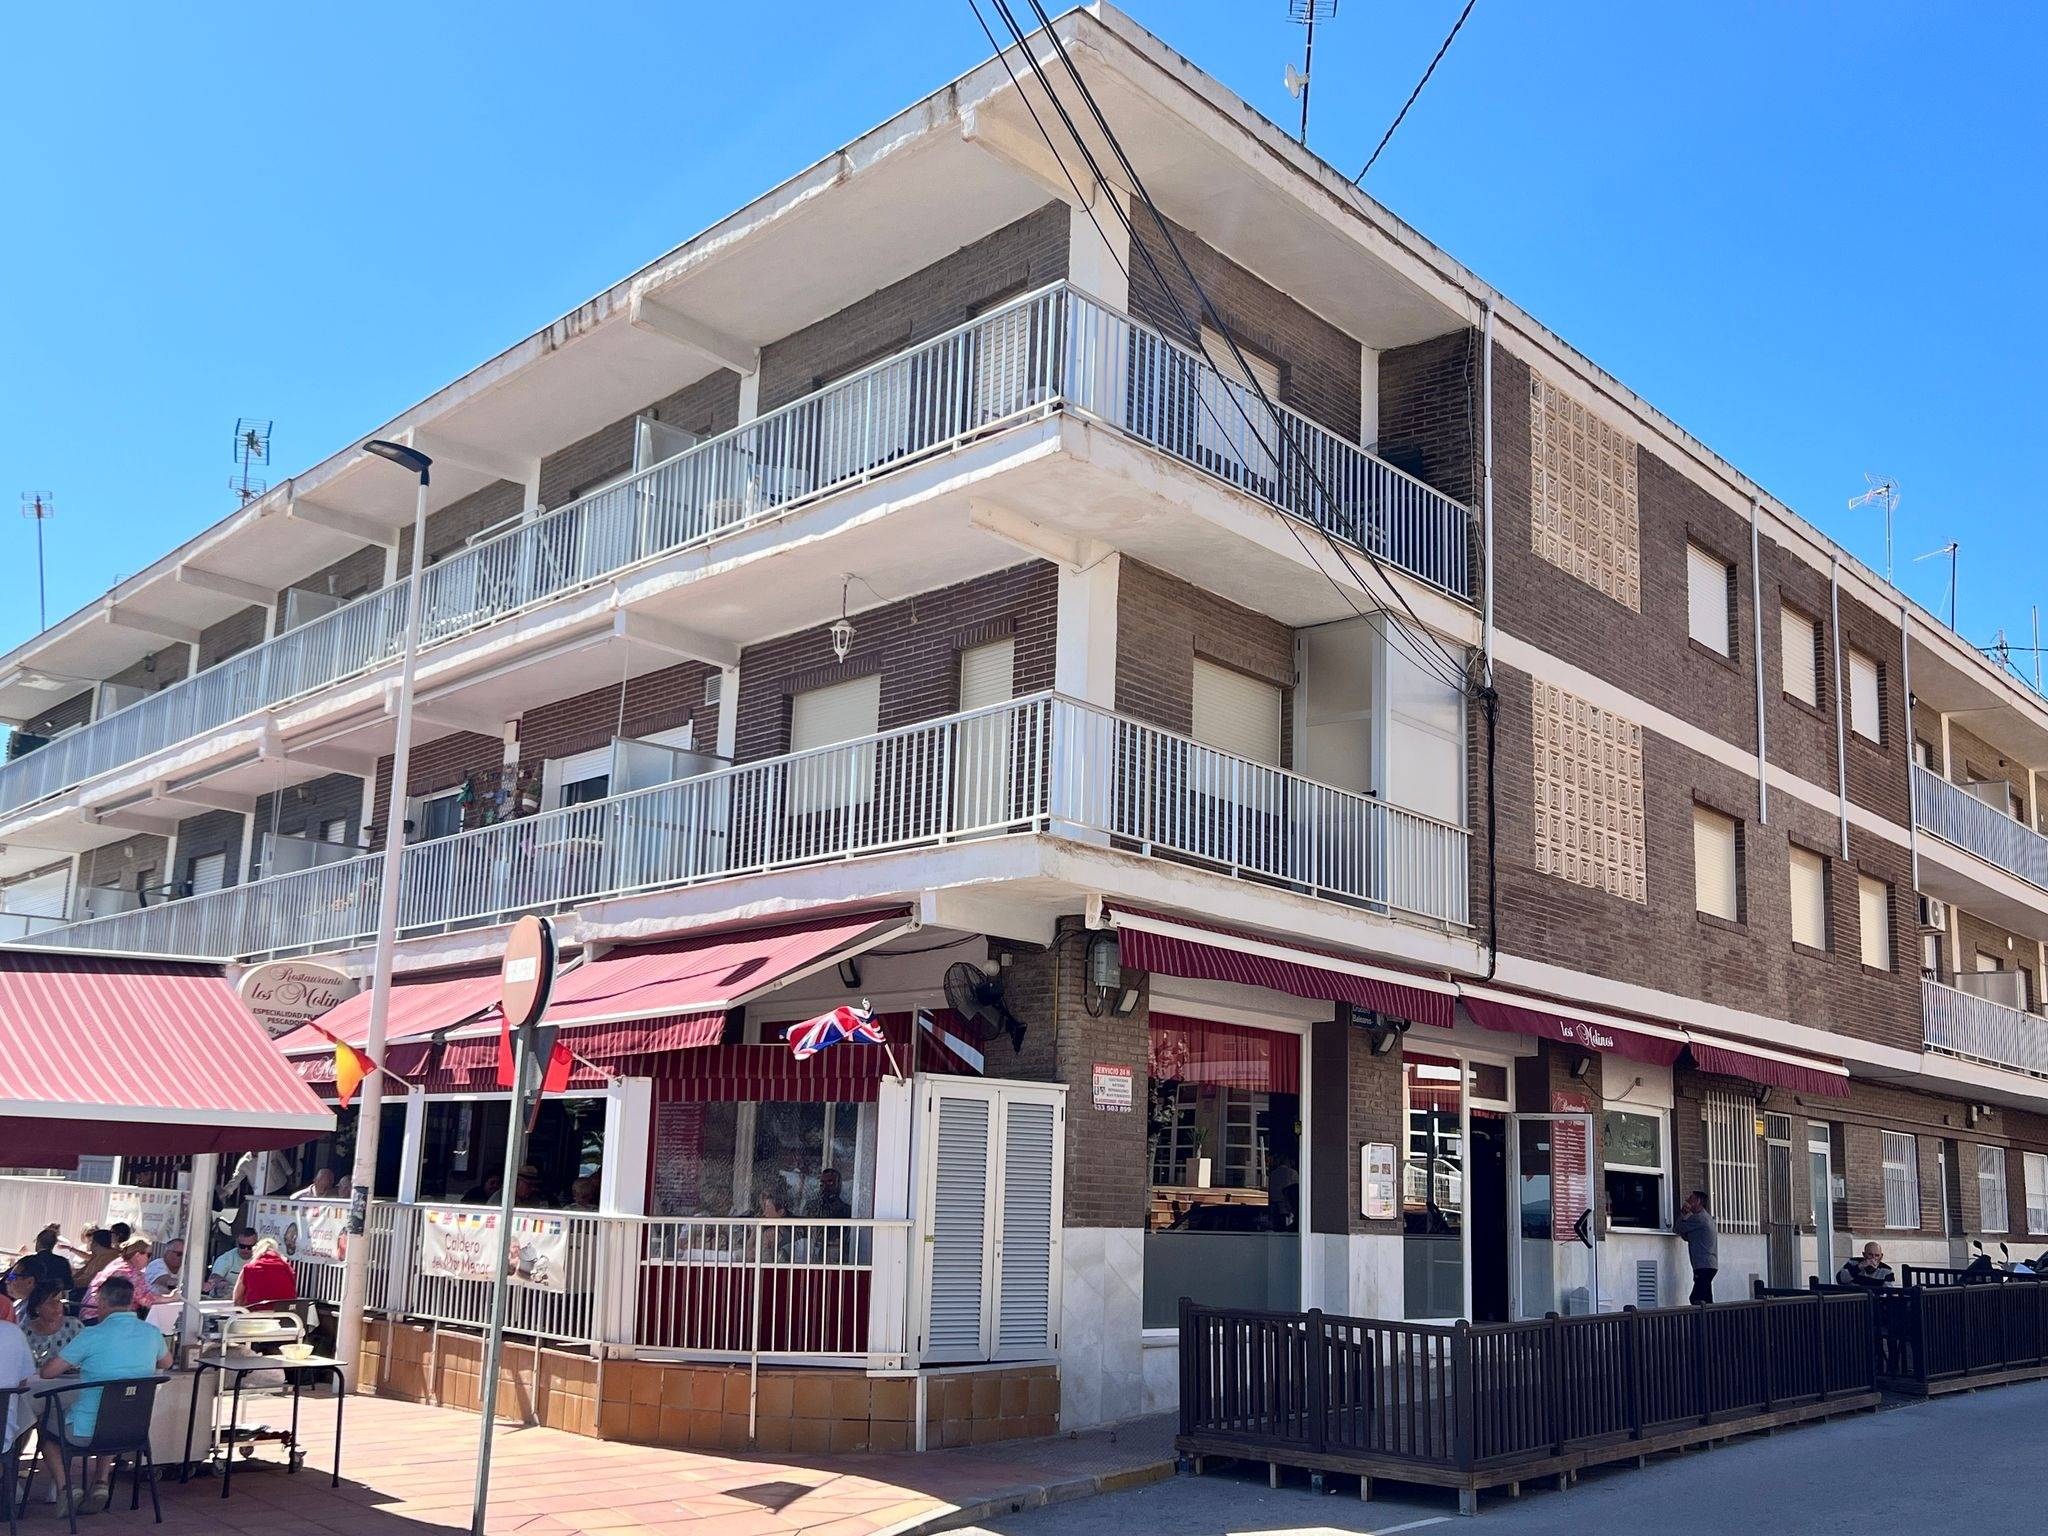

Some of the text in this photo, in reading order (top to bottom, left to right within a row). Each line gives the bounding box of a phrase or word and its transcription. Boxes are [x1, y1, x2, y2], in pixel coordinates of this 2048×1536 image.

[270, 967, 343, 986] Restaurante
[276, 981, 341, 1009] Molin
[252, 1008, 302, 1019] ESPECIALIDAD
[1576, 1022, 1614, 1048] Molinos
[1095, 1066, 1119, 1074] SERVICIO
[445, 1233, 480, 1253] Caldero
[462, 1256, 491, 1275] Menor
